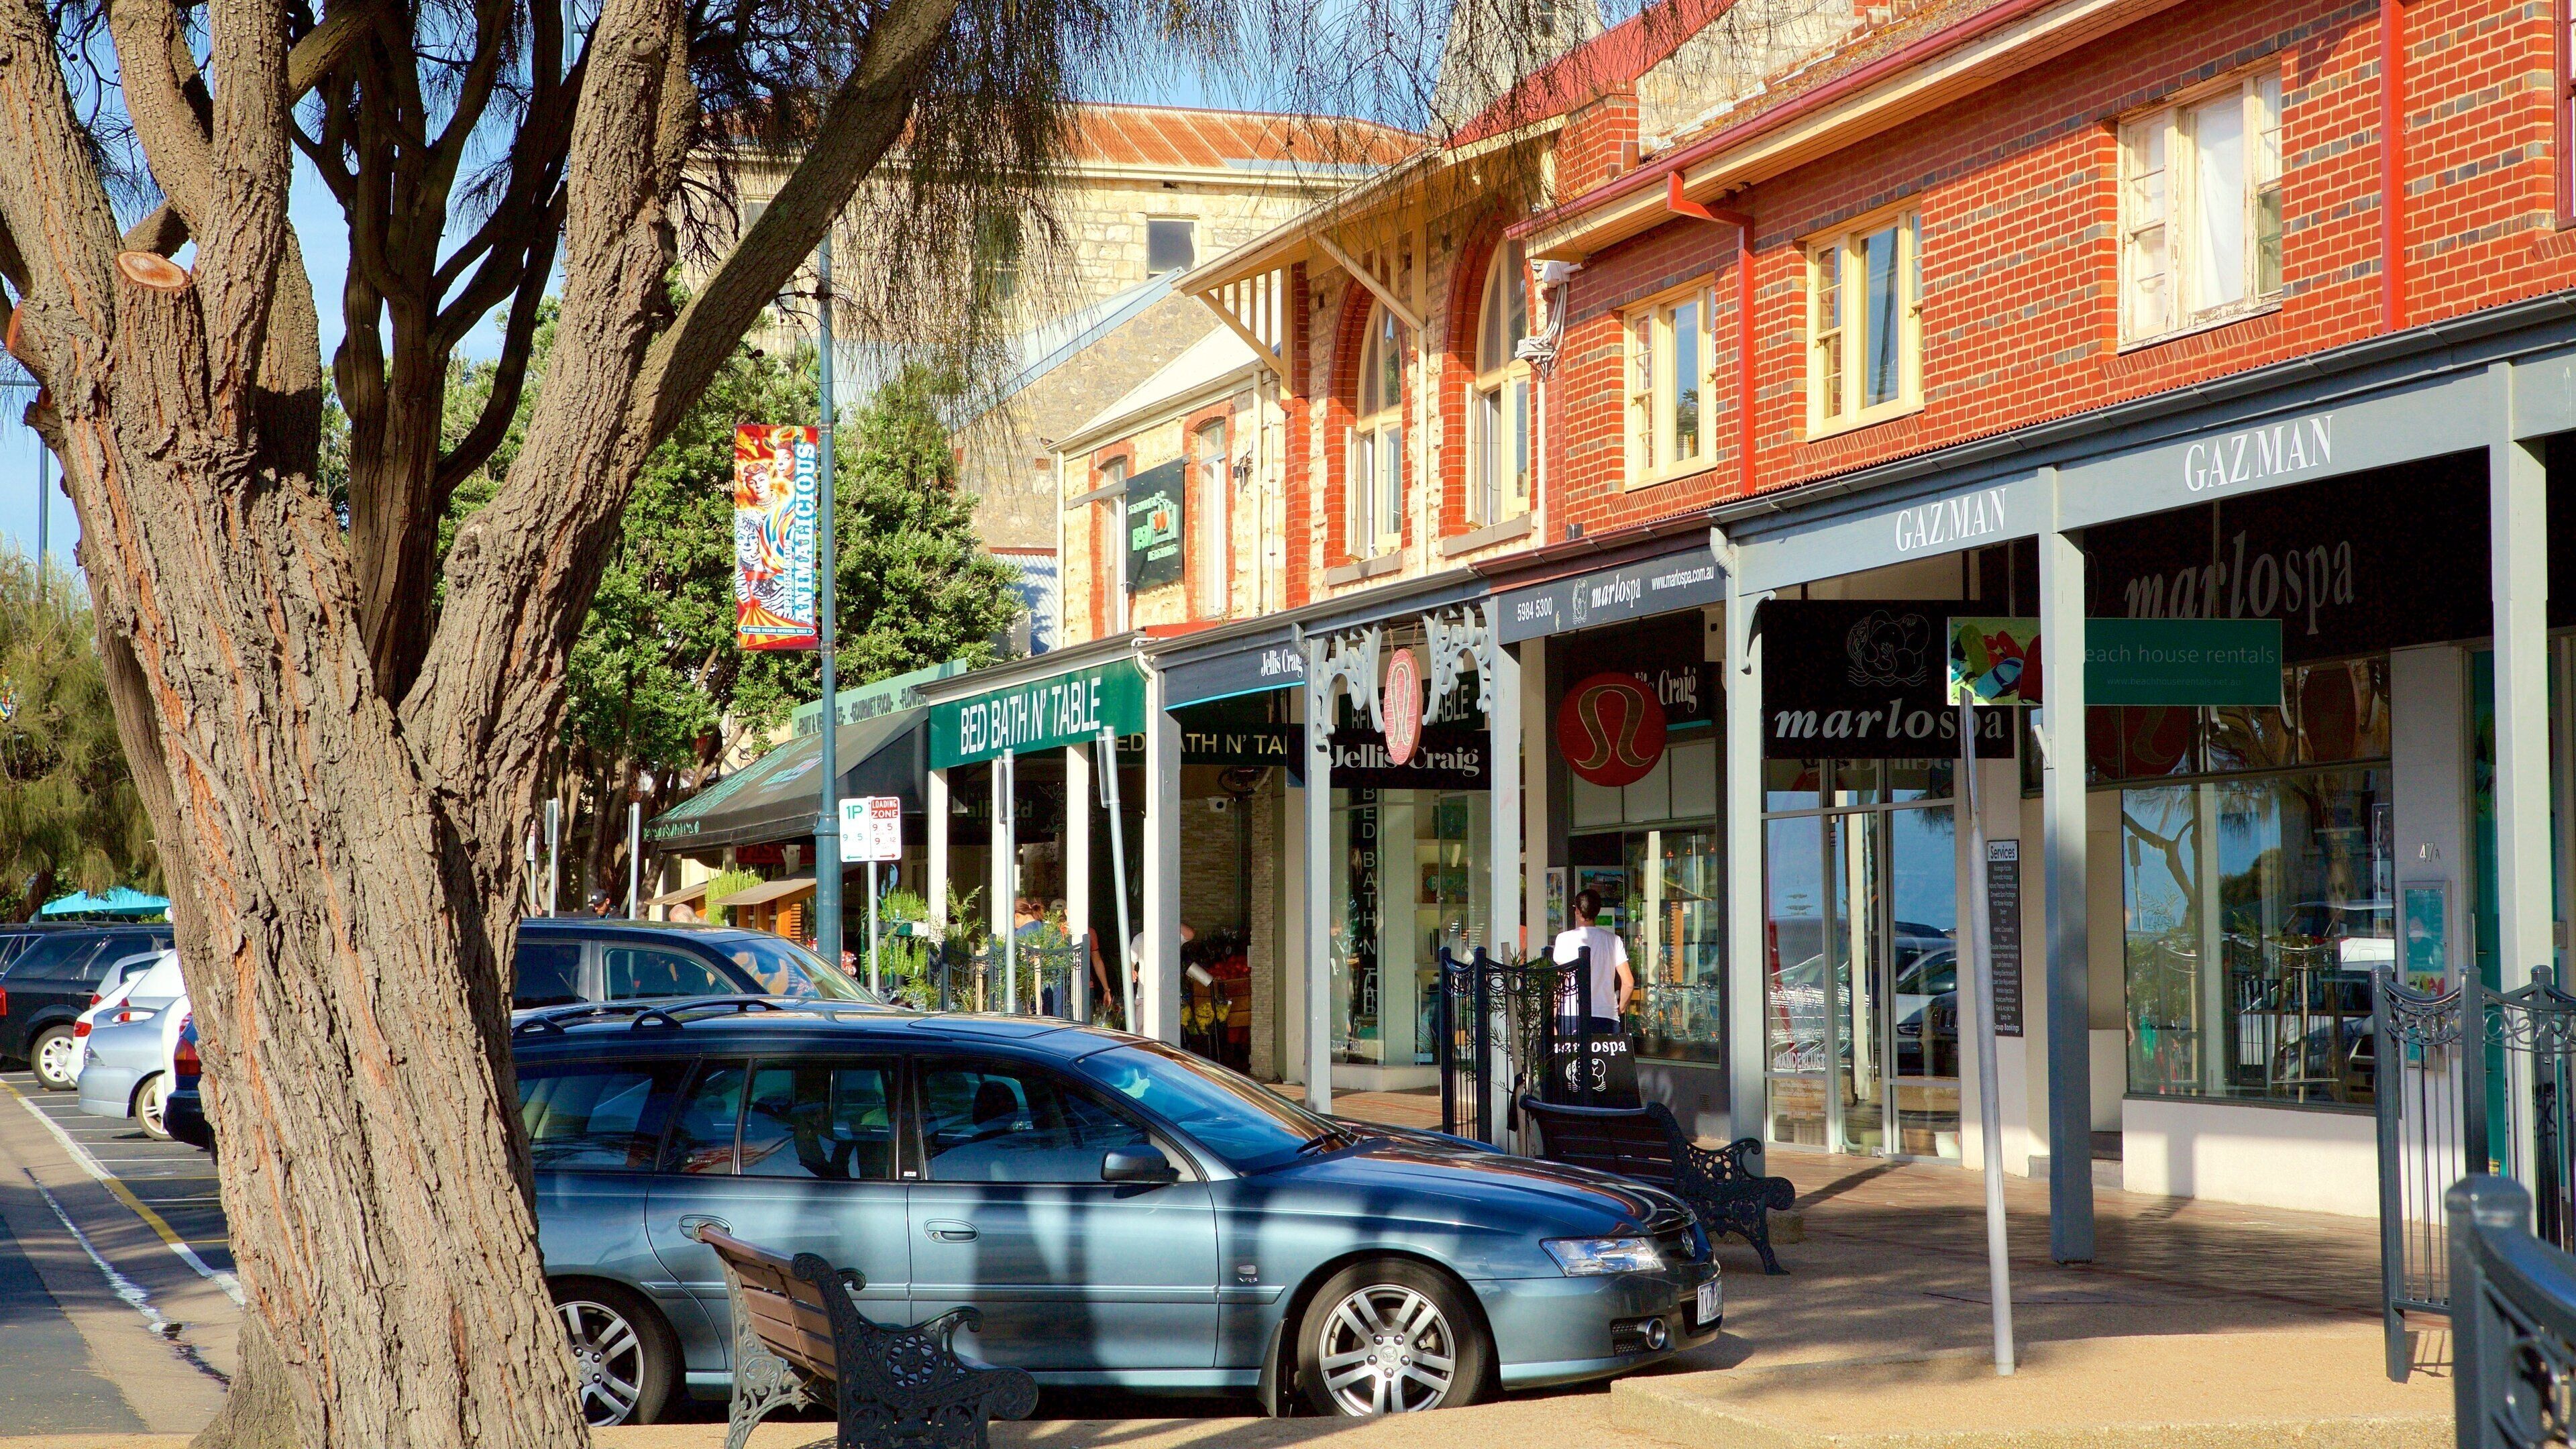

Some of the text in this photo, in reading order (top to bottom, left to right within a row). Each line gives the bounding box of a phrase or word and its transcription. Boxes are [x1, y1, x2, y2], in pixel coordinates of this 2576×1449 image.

[2184, 415, 2333, 492] GAZMAN
[1895, 488, 2007, 551] GAZMAN
[796, 443, 816, 625] ANIMALICIOUS
[1591, 573, 1641, 608] marlospa
[1652, 566, 1714, 590] www.marlospa.com.au
[1517, 596, 1552, 623] 5984 5300
[1260, 649, 1281, 676] Jellis
[2085, 644, 2275, 663] each house rentals
[1658, 666, 1697, 713] Craig
[961, 676, 1101, 755] BED BATH N' TABLE
[1116, 733, 1146, 752] ED
[1331, 743, 1480, 777] Jellis Craig
[846, 805, 863, 819] 1P
[871, 810, 898, 818] ZONE
[872, 800, 897, 809] LOADING
[1990, 845, 2015, 859] Services
[1362, 852, 1376, 927] BATH
[1774, 1051, 1826, 1069] WANDERLUST
